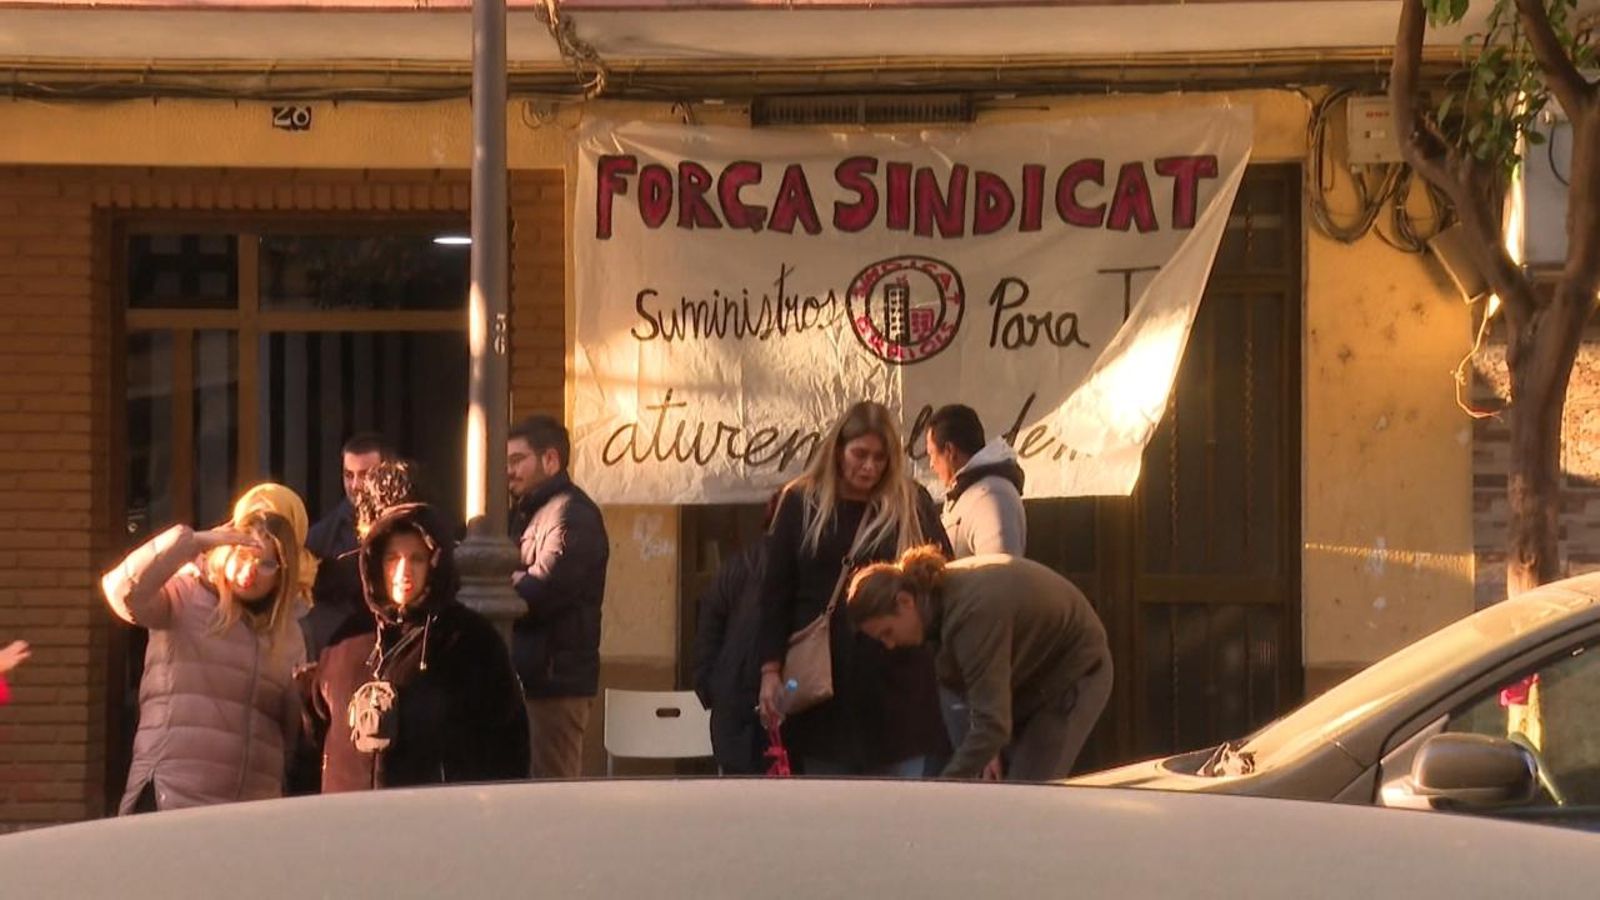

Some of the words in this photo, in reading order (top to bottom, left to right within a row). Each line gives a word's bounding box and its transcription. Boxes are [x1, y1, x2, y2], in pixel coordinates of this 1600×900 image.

[833, 155, 1218, 239] SINDICAT
[631, 262, 837, 342] Suministros
[989, 276, 1091, 350] Para
